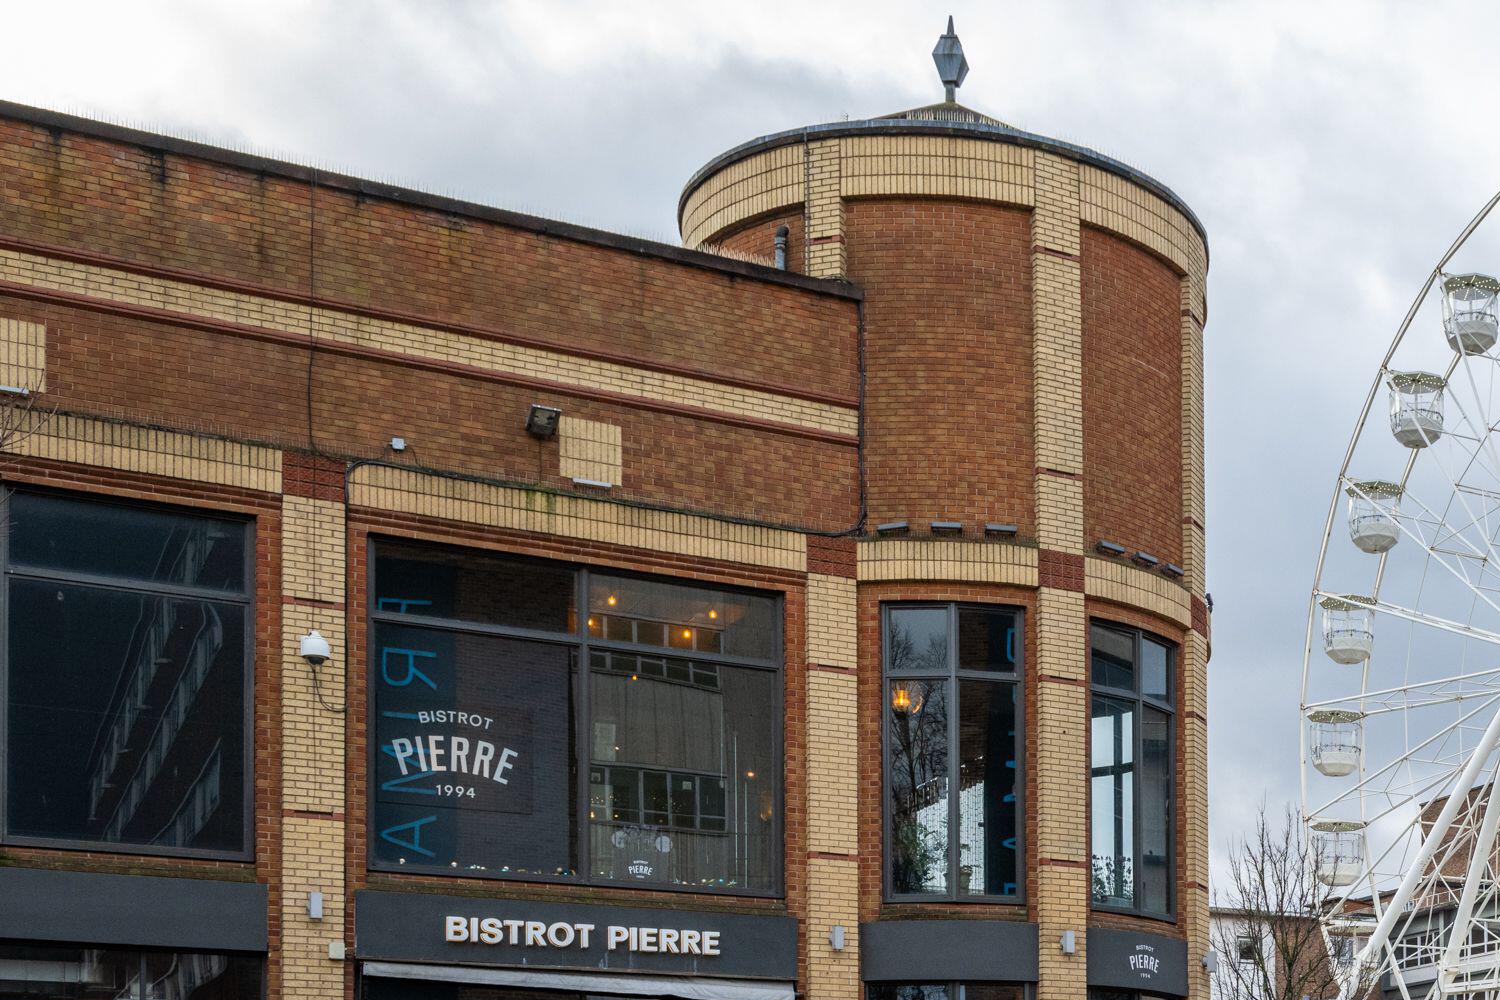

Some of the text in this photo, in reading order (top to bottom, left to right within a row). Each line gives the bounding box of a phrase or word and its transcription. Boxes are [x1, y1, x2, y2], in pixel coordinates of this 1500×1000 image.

[417, 710, 494, 730] BISTROT
[391, 735, 519, 785] PIERRE
[435, 784, 476, 799] 1994
[628, 865, 653, 876] PIERRE
[445, 915, 721, 957] BISTROT PIERRE
[1129, 954, 1160, 973] PIERRE
